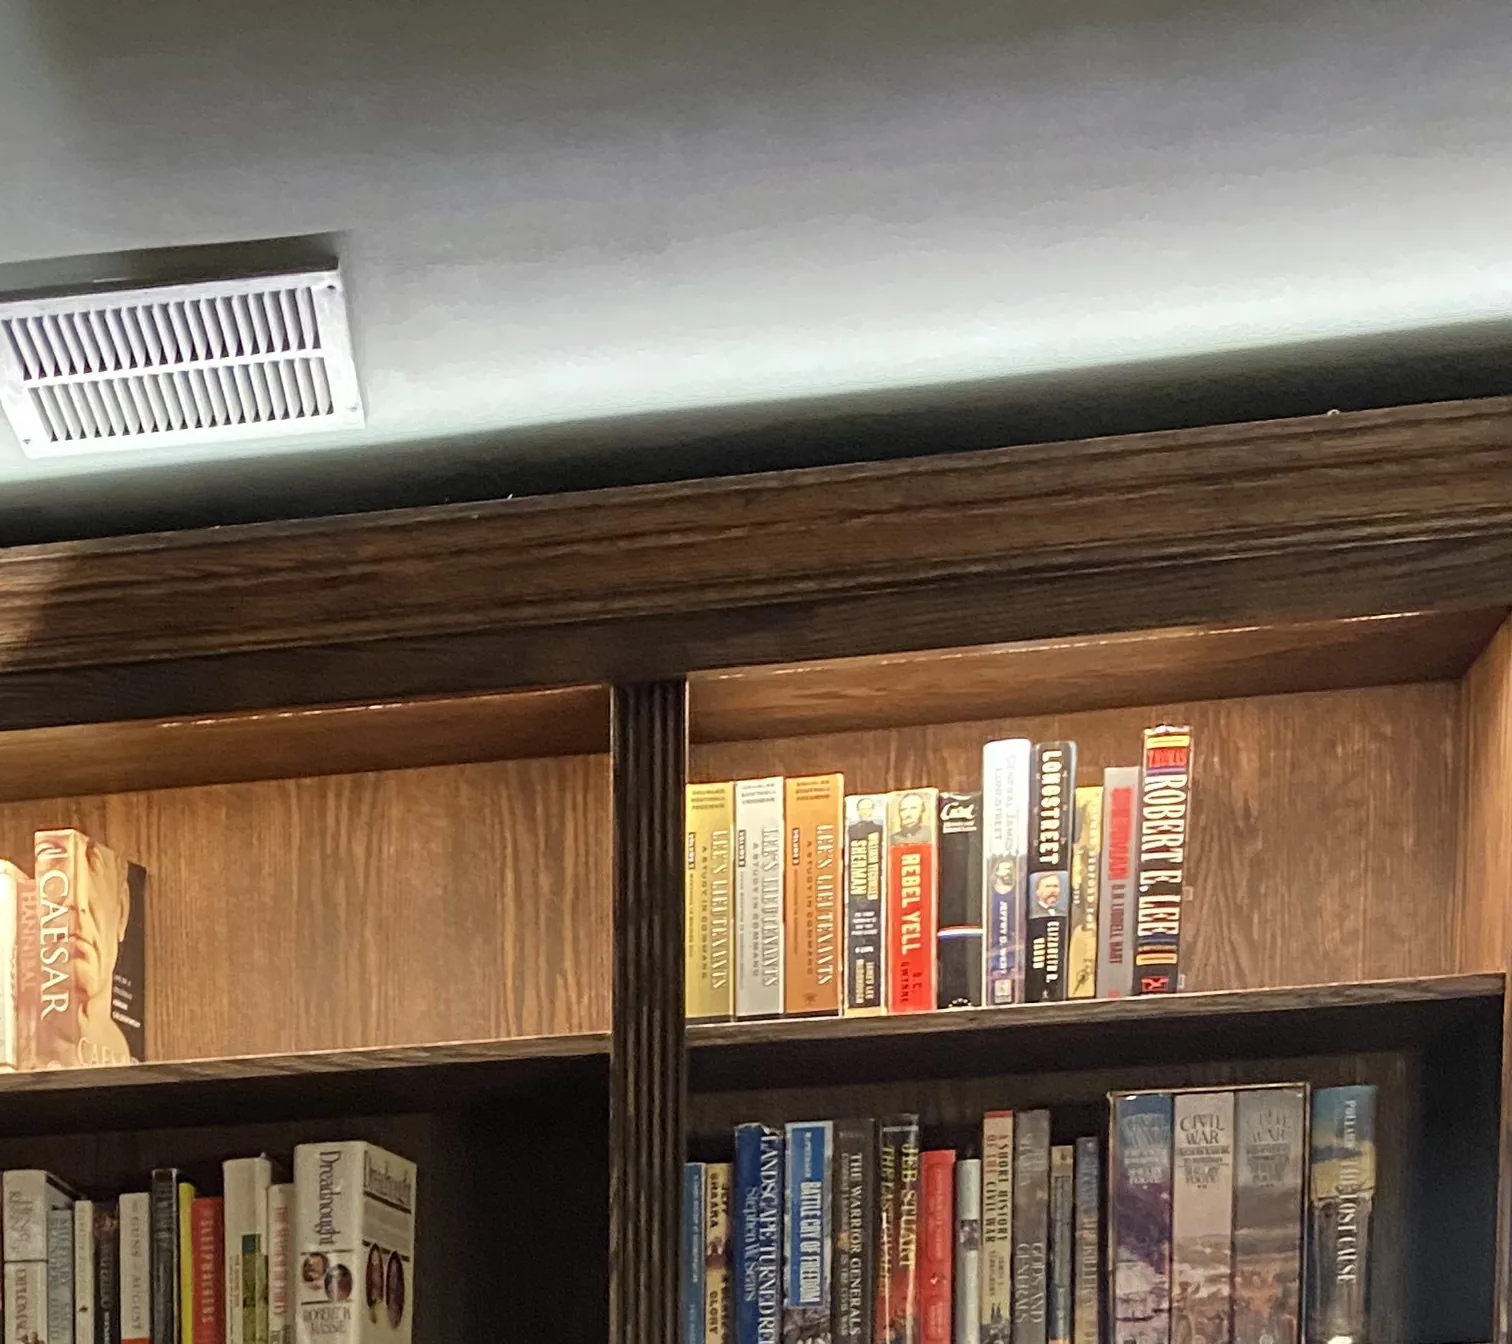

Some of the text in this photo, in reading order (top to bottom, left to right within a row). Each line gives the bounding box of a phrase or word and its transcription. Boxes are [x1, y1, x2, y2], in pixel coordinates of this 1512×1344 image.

[710, 829, 730, 870] LEE'S
[1039, 749, 1065, 866] LONGSTREET
[1137, 774, 1189, 937] ROBERT E. LEE
[762, 827, 781, 989] LEE'S LIEUTENANTS
[816, 824, 836, 986] LEE'S LIEUTENANTS
[850, 839, 869, 896] SHERMAN
[901, 853, 922, 956] REBEL YELL
[39, 868, 71, 1022] CAESAR
[710, 872, 729, 991] LIEUTENANTS
[308, 1149, 342, 1246] Dreadnought
[709, 1172, 719, 1228] SHAARA
[759, 1131, 780, 1240] LANDSCAPE
[986, 1217, 997, 1243] WAR
[998, 1190, 1009, 1241] HISTORY
[757, 1242, 779, 1314] TURNED
[799, 1180, 821, 1303] BATTLE CRY OF FREEDOM
[849, 1152, 863, 1336] THE WARRIOR GENERALS
